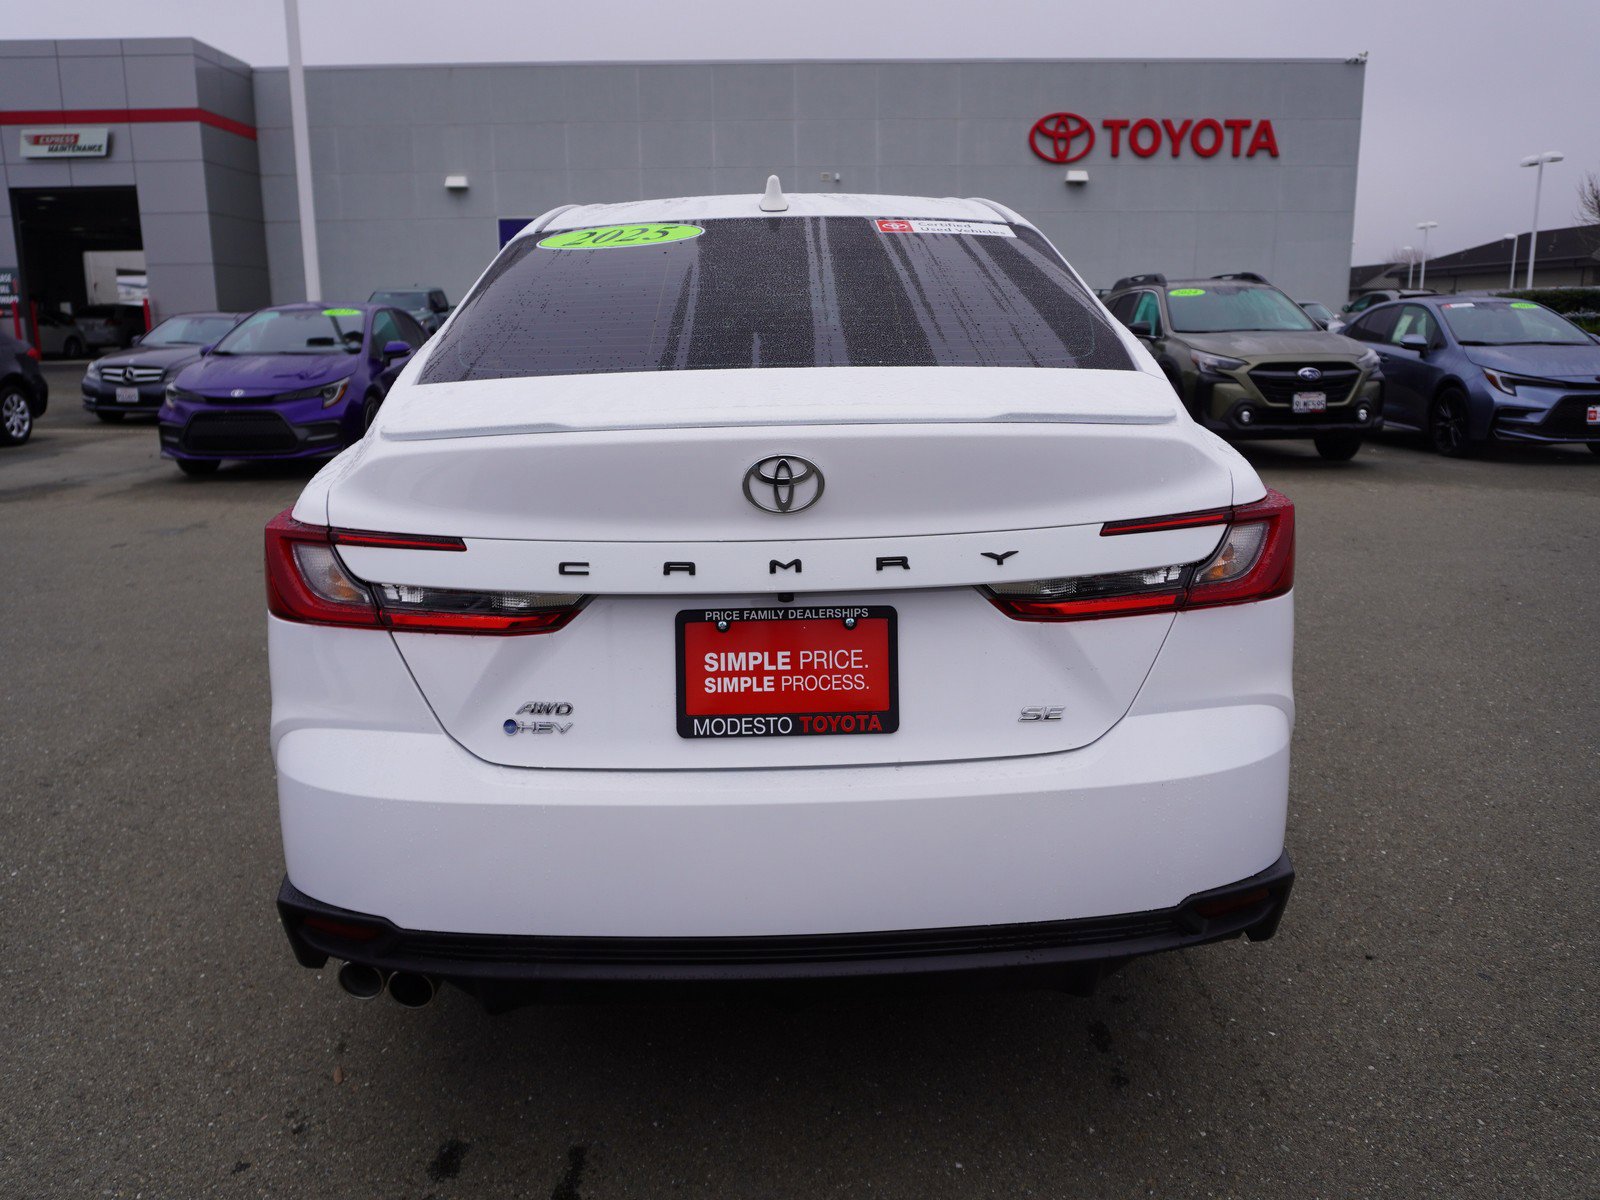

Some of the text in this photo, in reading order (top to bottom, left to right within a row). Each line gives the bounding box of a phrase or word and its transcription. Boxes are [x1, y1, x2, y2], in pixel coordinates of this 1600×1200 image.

[38, 134, 76, 144] EXPRESS
[1103, 118, 1279, 157] TOYOTA
[48, 144, 103, 153] MAINTENANCE
[562, 226, 679, 246] 2025
[955, 227, 1007, 235] Vehicles
[558, 550, 1019, 576] CAMRY
[705, 608, 869, 621] PRICE FAMILY DEALERSHIPS
[704, 649, 869, 672] SIMPLE PRICE.
[704, 674, 870, 694] SIMPLE PROCESS.
[515, 701, 575, 716] AWD
[1018, 705, 1066, 722] SE
[519, 721, 574, 734] HEV
[693, 714, 882, 736] MODESTO TOYOTA
